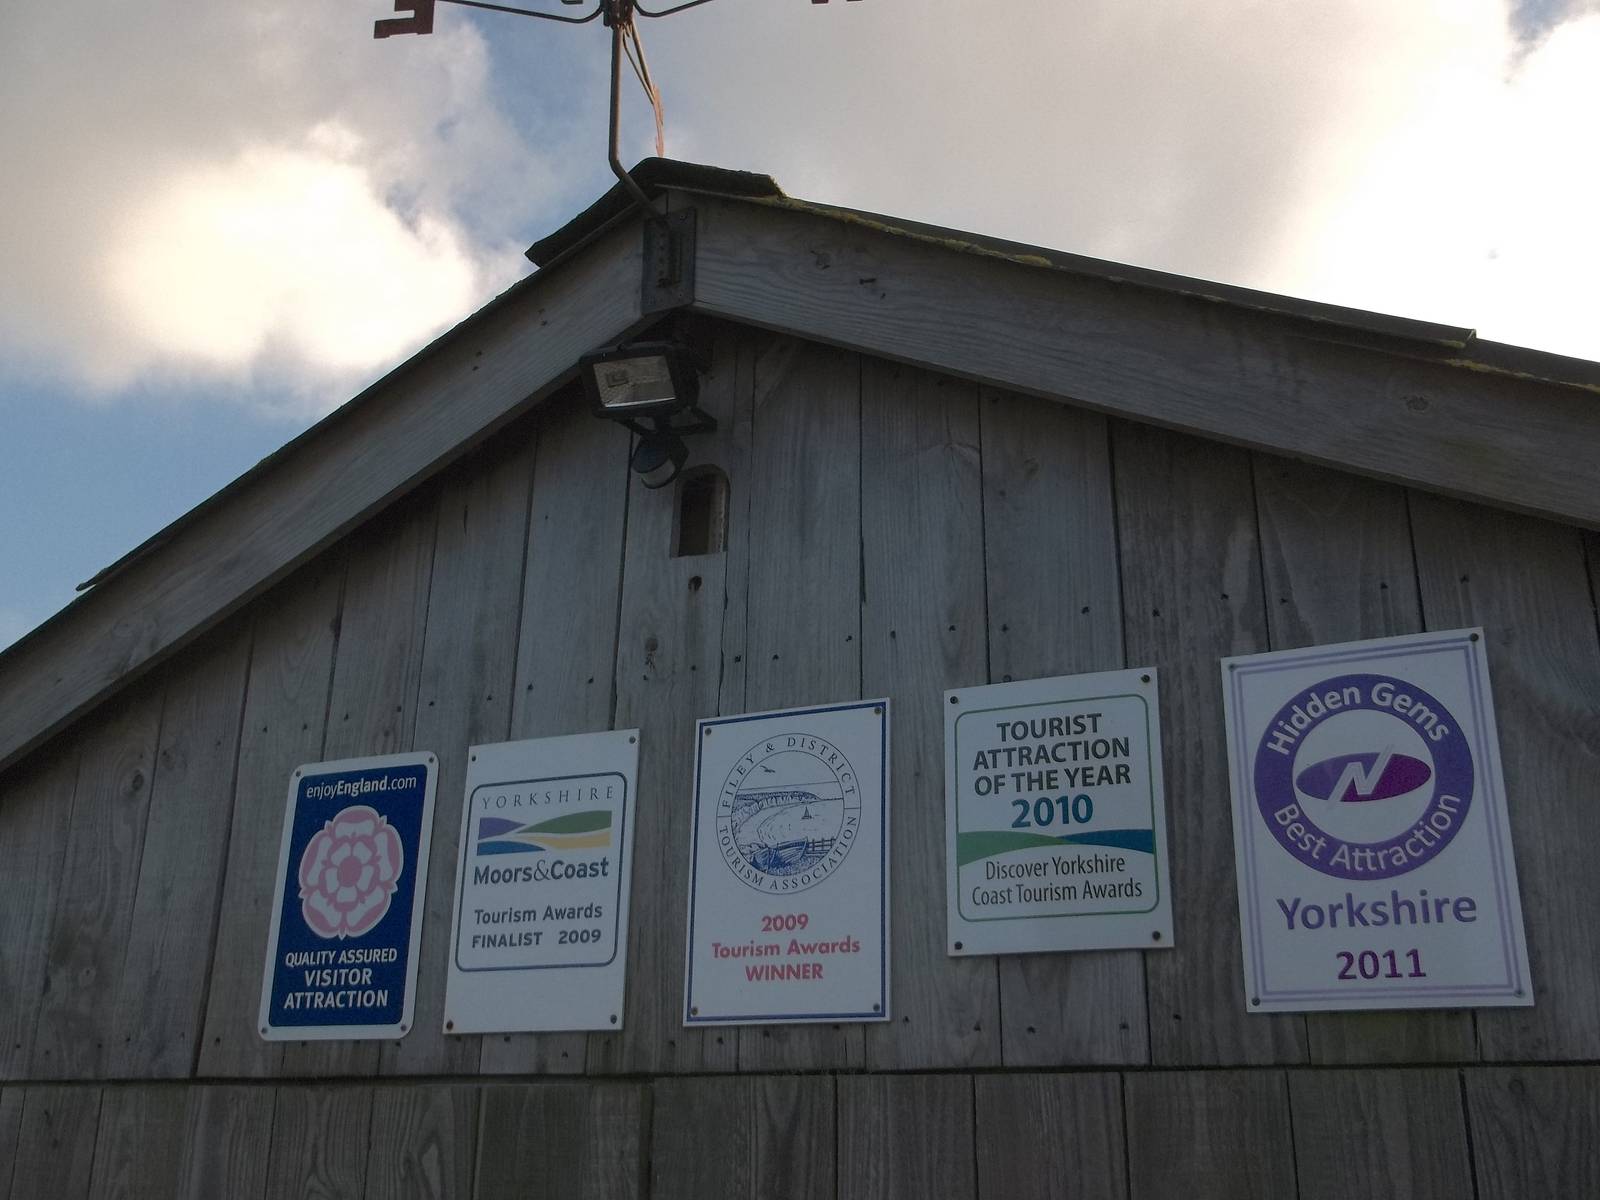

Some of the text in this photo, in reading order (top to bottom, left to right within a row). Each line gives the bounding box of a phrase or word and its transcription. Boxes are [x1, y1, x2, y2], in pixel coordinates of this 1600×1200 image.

[996, 713, 1102, 742] TOURIST
[1267, 682, 1449, 755] Hidden Gems
[972, 737, 1130, 770] ATTRACTION
[722, 737, 855, 809] FILEY & DISTRICT
[974, 763, 1131, 796] OF THE YEAR
[306, 775, 417, 800] enjoyEngland.com
[481, 785, 614, 810] YORKSHIRE
[1011, 793, 1093, 828] 2010
[1273, 793, 1461, 872] Best Attraction
[719, 816, 857, 890] TOURISM ASSOCIATION
[985, 853, 1126, 881] Discover Yorkshire
[972, 878, 1143, 906] Coast Tourism Awards
[474, 903, 603, 925] Tourism Awards
[761, 913, 809, 932] 2009
[1276, 889, 1477, 930] Yorkshire
[471, 929, 601, 949] FINALIST 2009
[712, 935, 860, 959] Tourism Awards
[285, 948, 398, 967] QUALITY ASSURED
[1336, 949, 1427, 980] 2011
[304, 968, 372, 987] VISITOR
[745, 963, 823, 982] WINNER
[284, 989, 389, 1010] ATTRACTION
